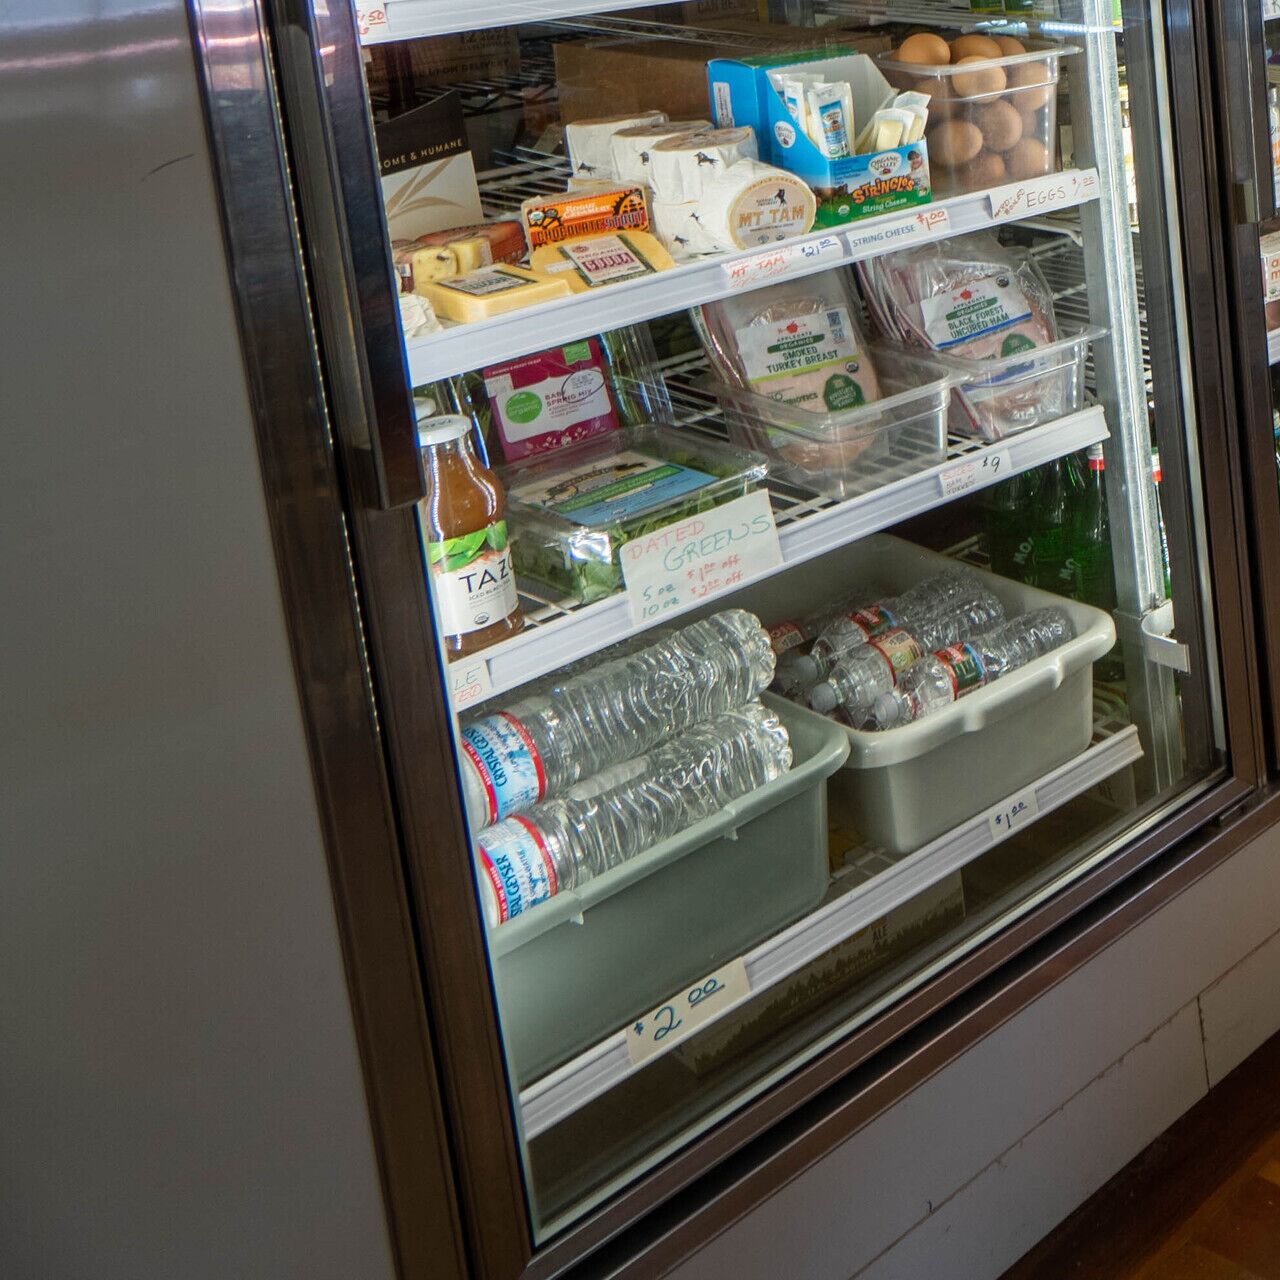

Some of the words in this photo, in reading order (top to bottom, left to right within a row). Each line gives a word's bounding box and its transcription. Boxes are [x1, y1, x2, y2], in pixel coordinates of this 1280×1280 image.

[421, 139, 463, 157] HUMANE
[870, 155, 900, 166] ORGANIC
[1026, 186, 1067, 208] EGGS
[738, 210, 765, 228] MT
[769, 205, 805, 223] TAM
[536, 218, 604, 242] CHOCOLATE
[852, 231, 883, 248] STRING
[884, 224, 916, 241] CHEESE
[947, 315, 976, 329] BLACK
[975, 306, 1004, 321] FOREST
[951, 322, 987, 338] UNCURED
[989, 315, 1009, 329] HAM
[766, 357, 802, 374] TURKEY
[804, 350, 840, 367] BREAST
[782, 346, 818, 360] SMOKED
[627, 520, 705, 560] DATED
[663, 513, 772, 572] GREENS
[481, 747, 507, 788] CRYSTAL
[495, 854, 520, 895] GEYSER
